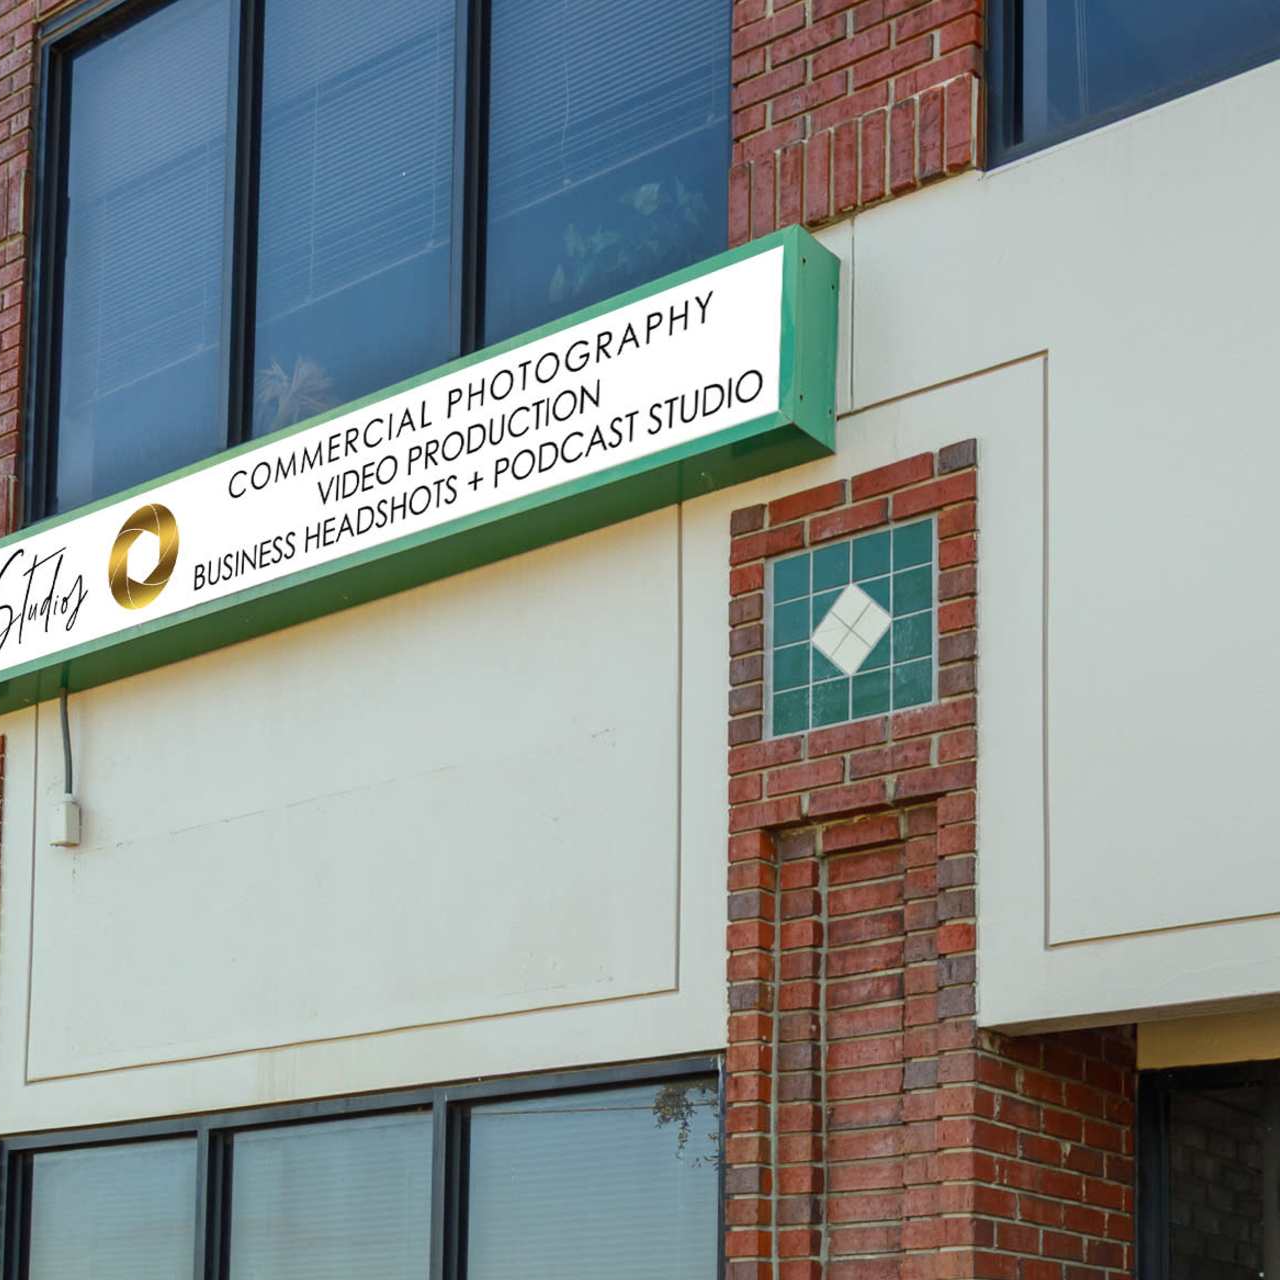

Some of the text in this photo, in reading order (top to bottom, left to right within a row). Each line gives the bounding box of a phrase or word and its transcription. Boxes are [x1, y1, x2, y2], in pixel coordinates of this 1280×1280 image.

[193, 369, 763, 591] BUSINESS HEADSHOTS + PODCAST STUDIO
[229, 290, 714, 498] COMMERCIAL PHOTOGRAPHY
[317, 379, 601, 504] VIDEO PRODUCTION
